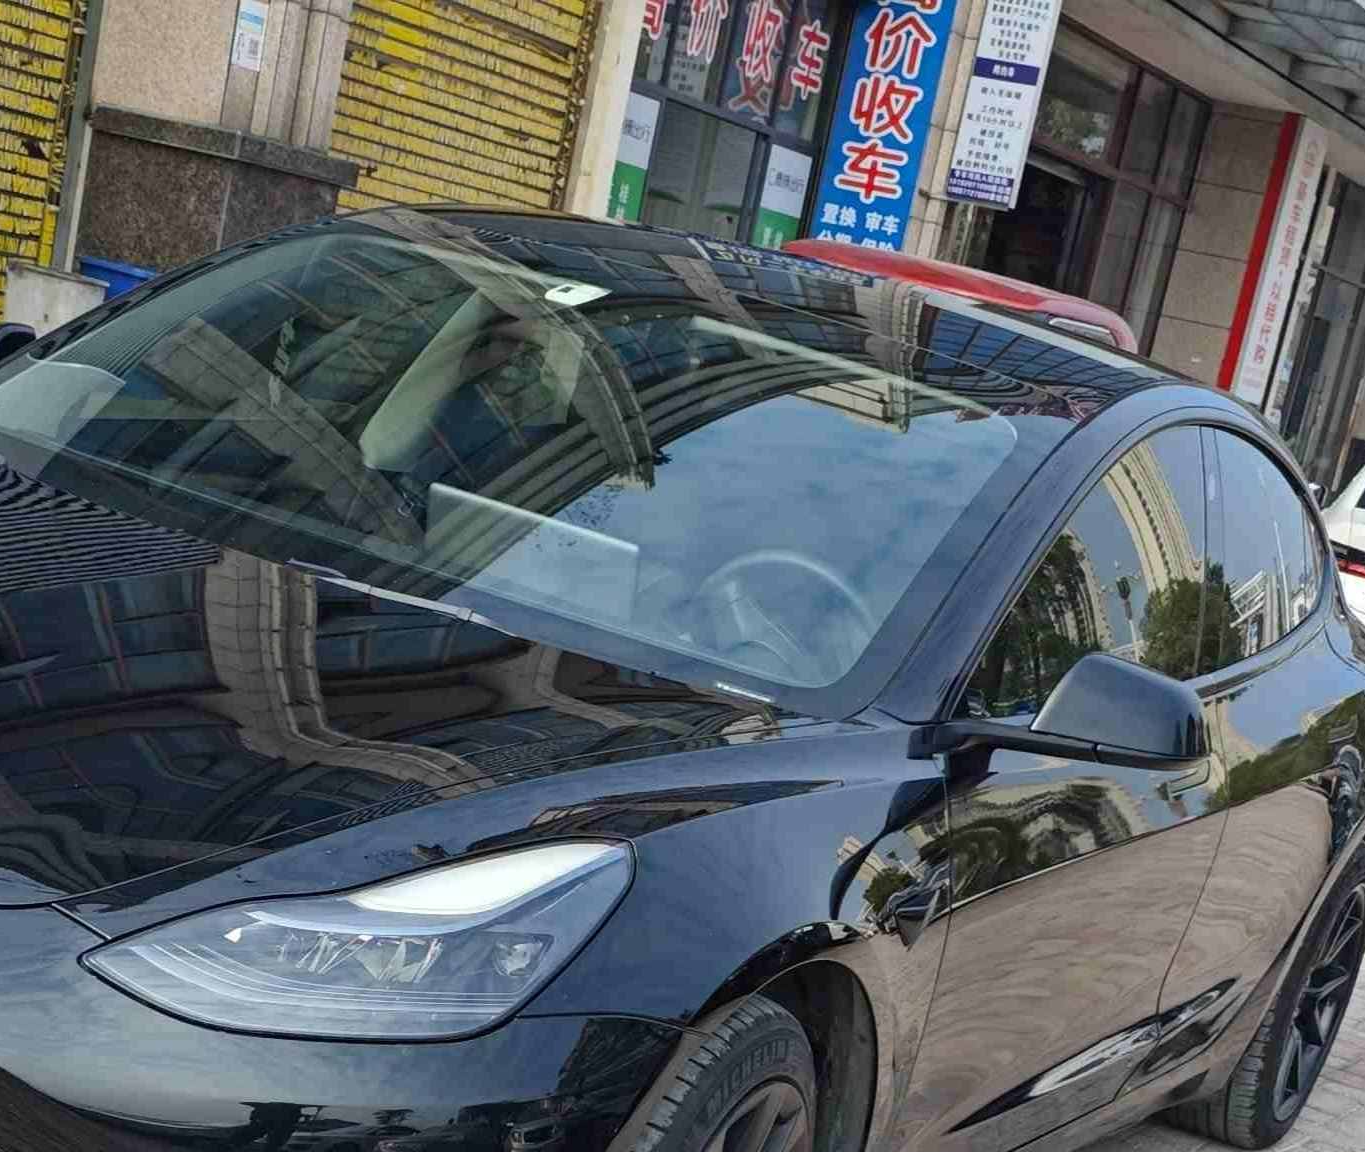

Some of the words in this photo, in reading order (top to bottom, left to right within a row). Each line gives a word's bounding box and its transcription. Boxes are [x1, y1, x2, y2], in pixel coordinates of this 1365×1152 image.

[643, 0, 830, 99] 价收车
[835, 0, 942, 203] 价收车
[820, 202, 857, 228] 置换
[865, 211, 900, 235] 审车
